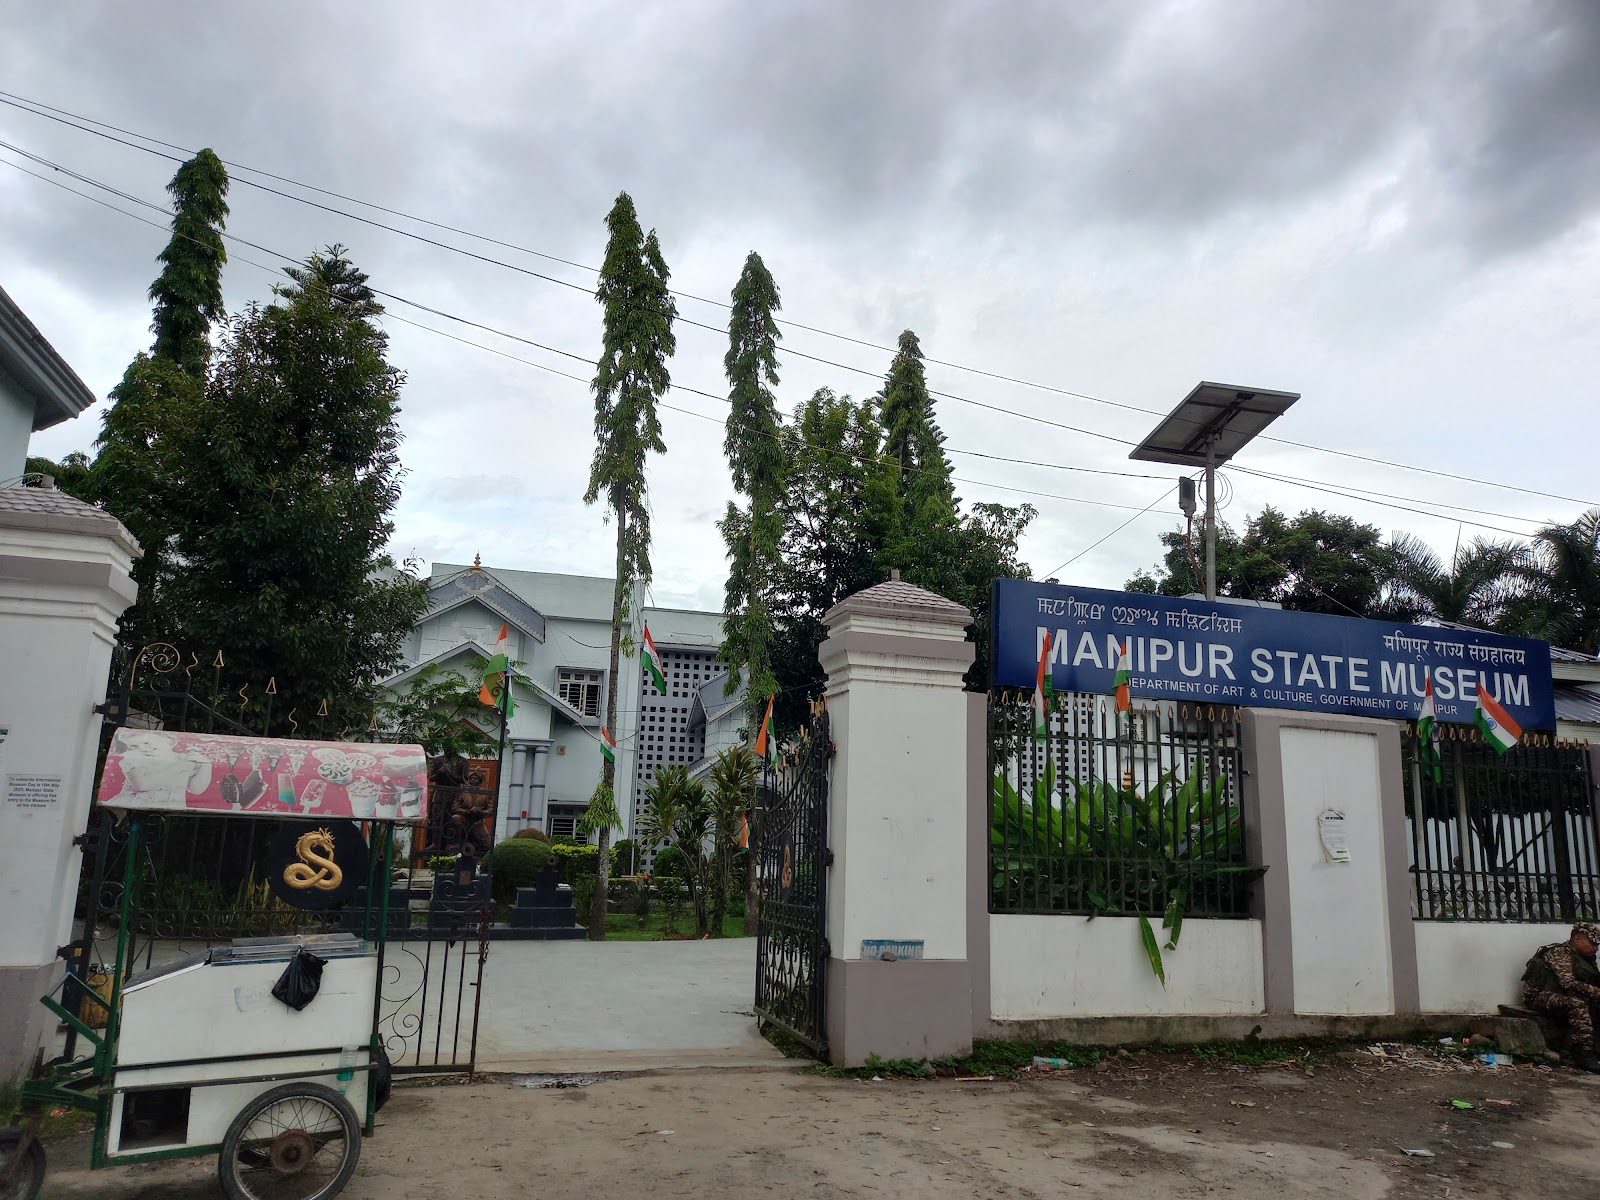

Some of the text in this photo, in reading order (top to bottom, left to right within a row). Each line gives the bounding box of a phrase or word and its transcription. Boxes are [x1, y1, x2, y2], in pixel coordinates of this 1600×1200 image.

[1383, 629, 1526, 666] मणिपूर राज्य संग्रहालय
[1036, 626, 1531, 707] MANIPUR STATE MUSEUM
[1204, 684, 1219, 695] OF
[1222, 686, 1244, 698] ART
[1250, 688, 1258, 698] &
[1320, 694, 1391, 709] GOVERNMENT
[1395, 700, 1409, 711] OF
[1413, 702, 1458, 715] MIPUR
[863, 945, 877, 957] NO
